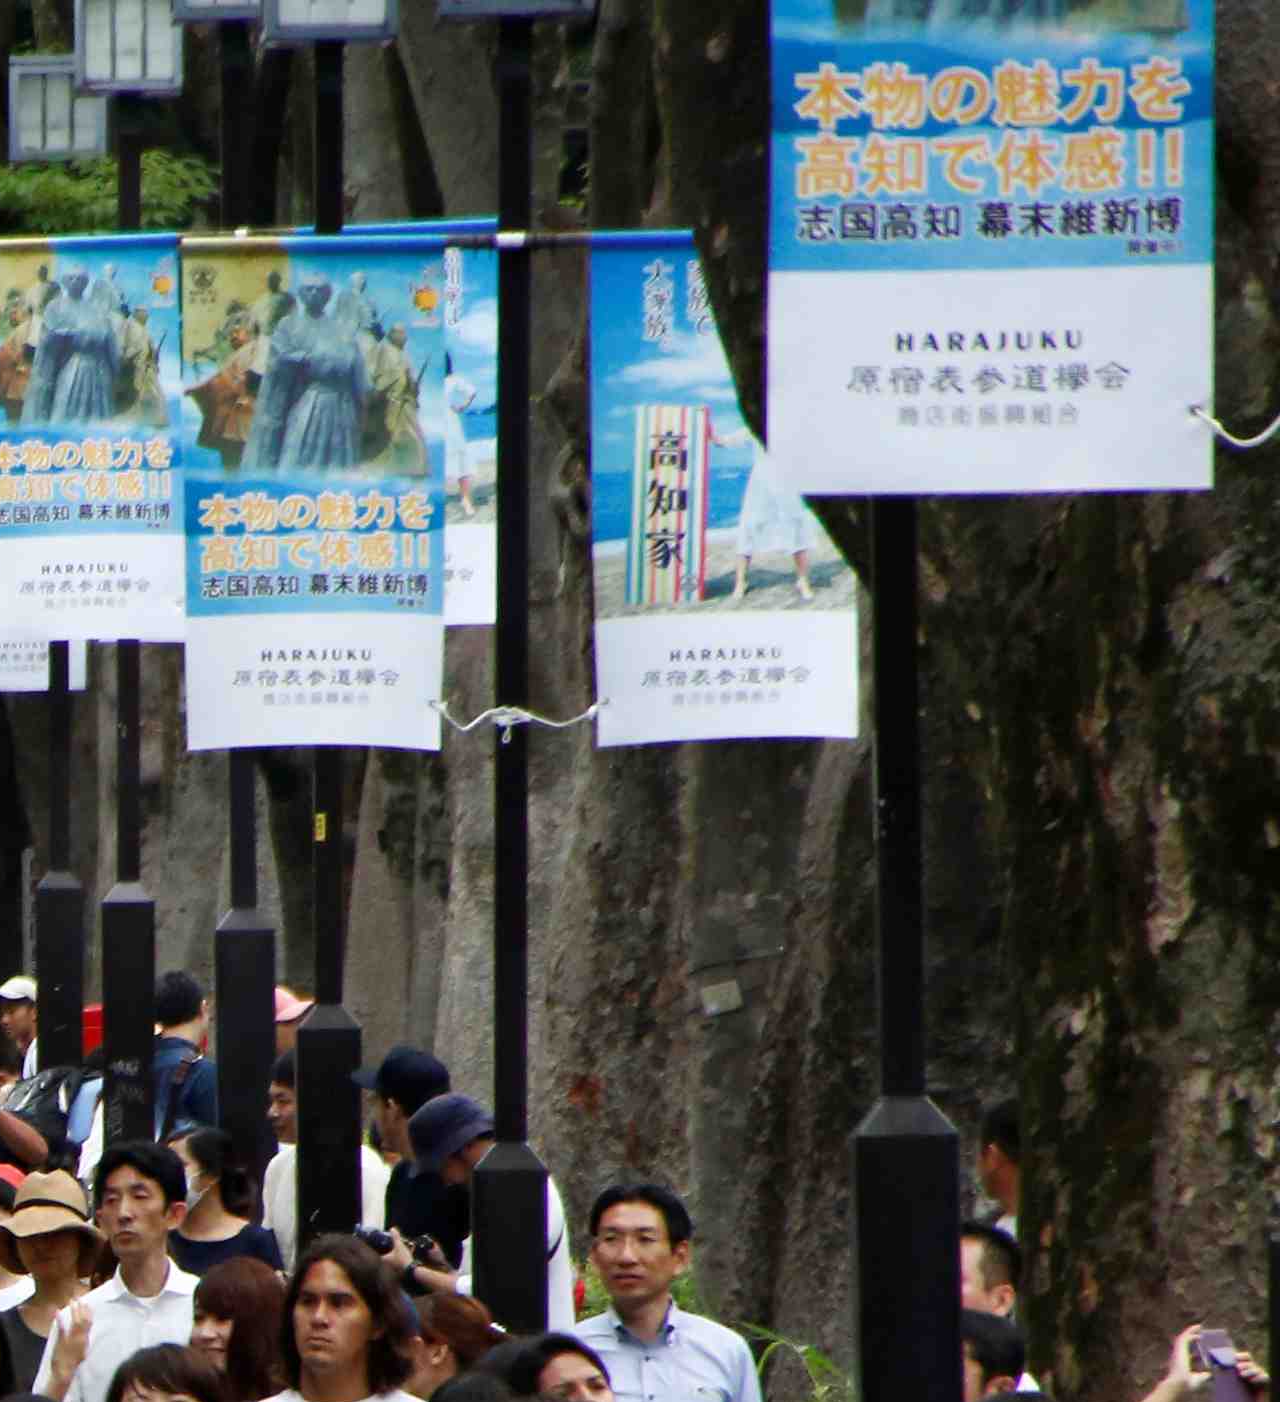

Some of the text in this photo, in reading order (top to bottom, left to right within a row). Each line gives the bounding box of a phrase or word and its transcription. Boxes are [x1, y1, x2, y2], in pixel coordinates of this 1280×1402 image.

[793, 57, 1192, 130] 本物の魅力を
[794, 125, 1184, 198] 高知で体感!!
[797, 196, 1182, 241] 志国高知 幕末維新博
[895, 330, 1083, 352] HARAJUKU
[199, 490, 434, 536] 本物の魅力を
[647, 430, 688, 570] 高知家
[41, 562, 129, 575] HARAJUKU
[201, 533, 431, 574] 高知で体感!!
[203, 574, 429, 598] 志国高知 幕末維新博
[261, 649, 373, 662] HARAJUKU
[669, 647, 783, 662] HARAJUKU
